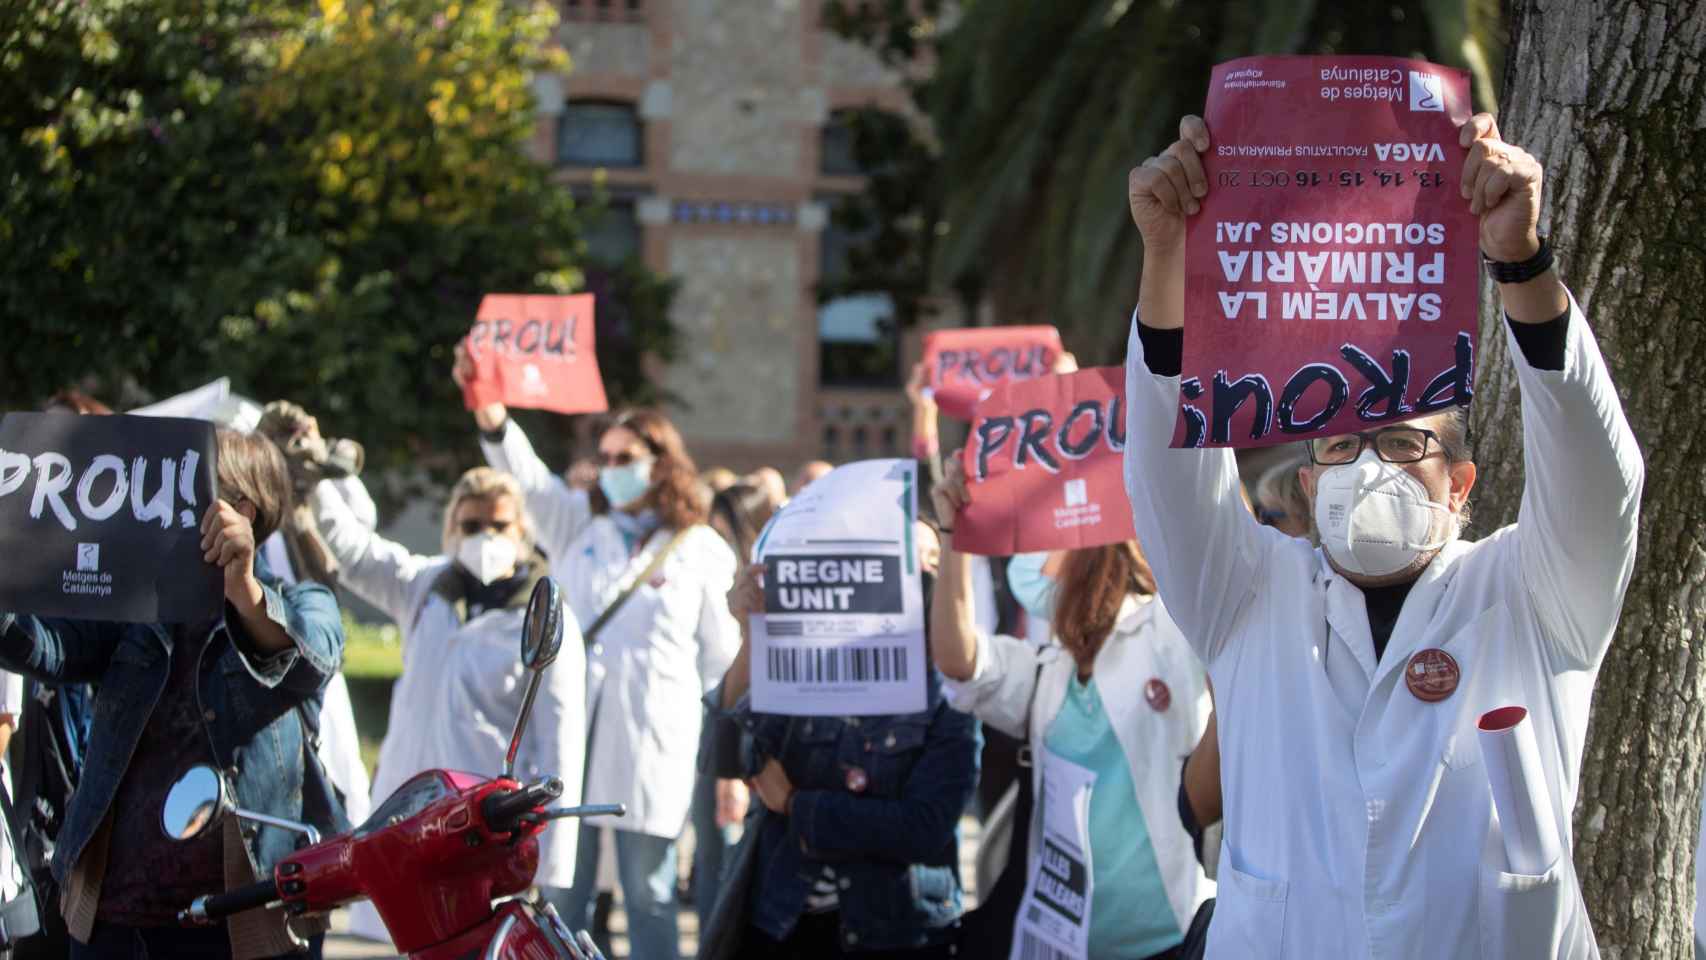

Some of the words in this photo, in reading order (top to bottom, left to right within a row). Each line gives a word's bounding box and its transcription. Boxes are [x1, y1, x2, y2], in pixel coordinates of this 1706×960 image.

[1320, 65, 1403, 85] Catalunya
[1320, 86, 1340, 99] de
[1344, 87, 1403, 102] Metges
[1217, 145, 1237, 156] ICS
[1295, 145, 1368, 156] FACULTATIUS
[1374, 143, 1446, 161] VAGA
[1218, 170, 1240, 187] 20
[1296, 171, 1321, 187] 16
[1340, 171, 1365, 186] 15
[1373, 170, 1404, 186] 14,
[1412, 170, 1443, 186] 13,
[1216, 221, 1261, 243] JA!
[1271, 222, 1446, 244] SOLUCIONS
[1217, 250, 1445, 291] PRIMÀRIA
[1217, 291, 1267, 319] LA
[1282, 292, 1442, 321] SALVEM
[468, 314, 577, 363] PROU!
[936, 345, 1048, 386] PROU!
[1180, 330, 1473, 448] PROU!
[0, 448, 200, 531] PROU!
[63, 570, 98, 584] Metges
[100, 570, 112, 582] de
[777, 560, 884, 583] REGNE
[62, 582, 112, 597] Catalunya
[779, 587, 854, 610] UNIT
